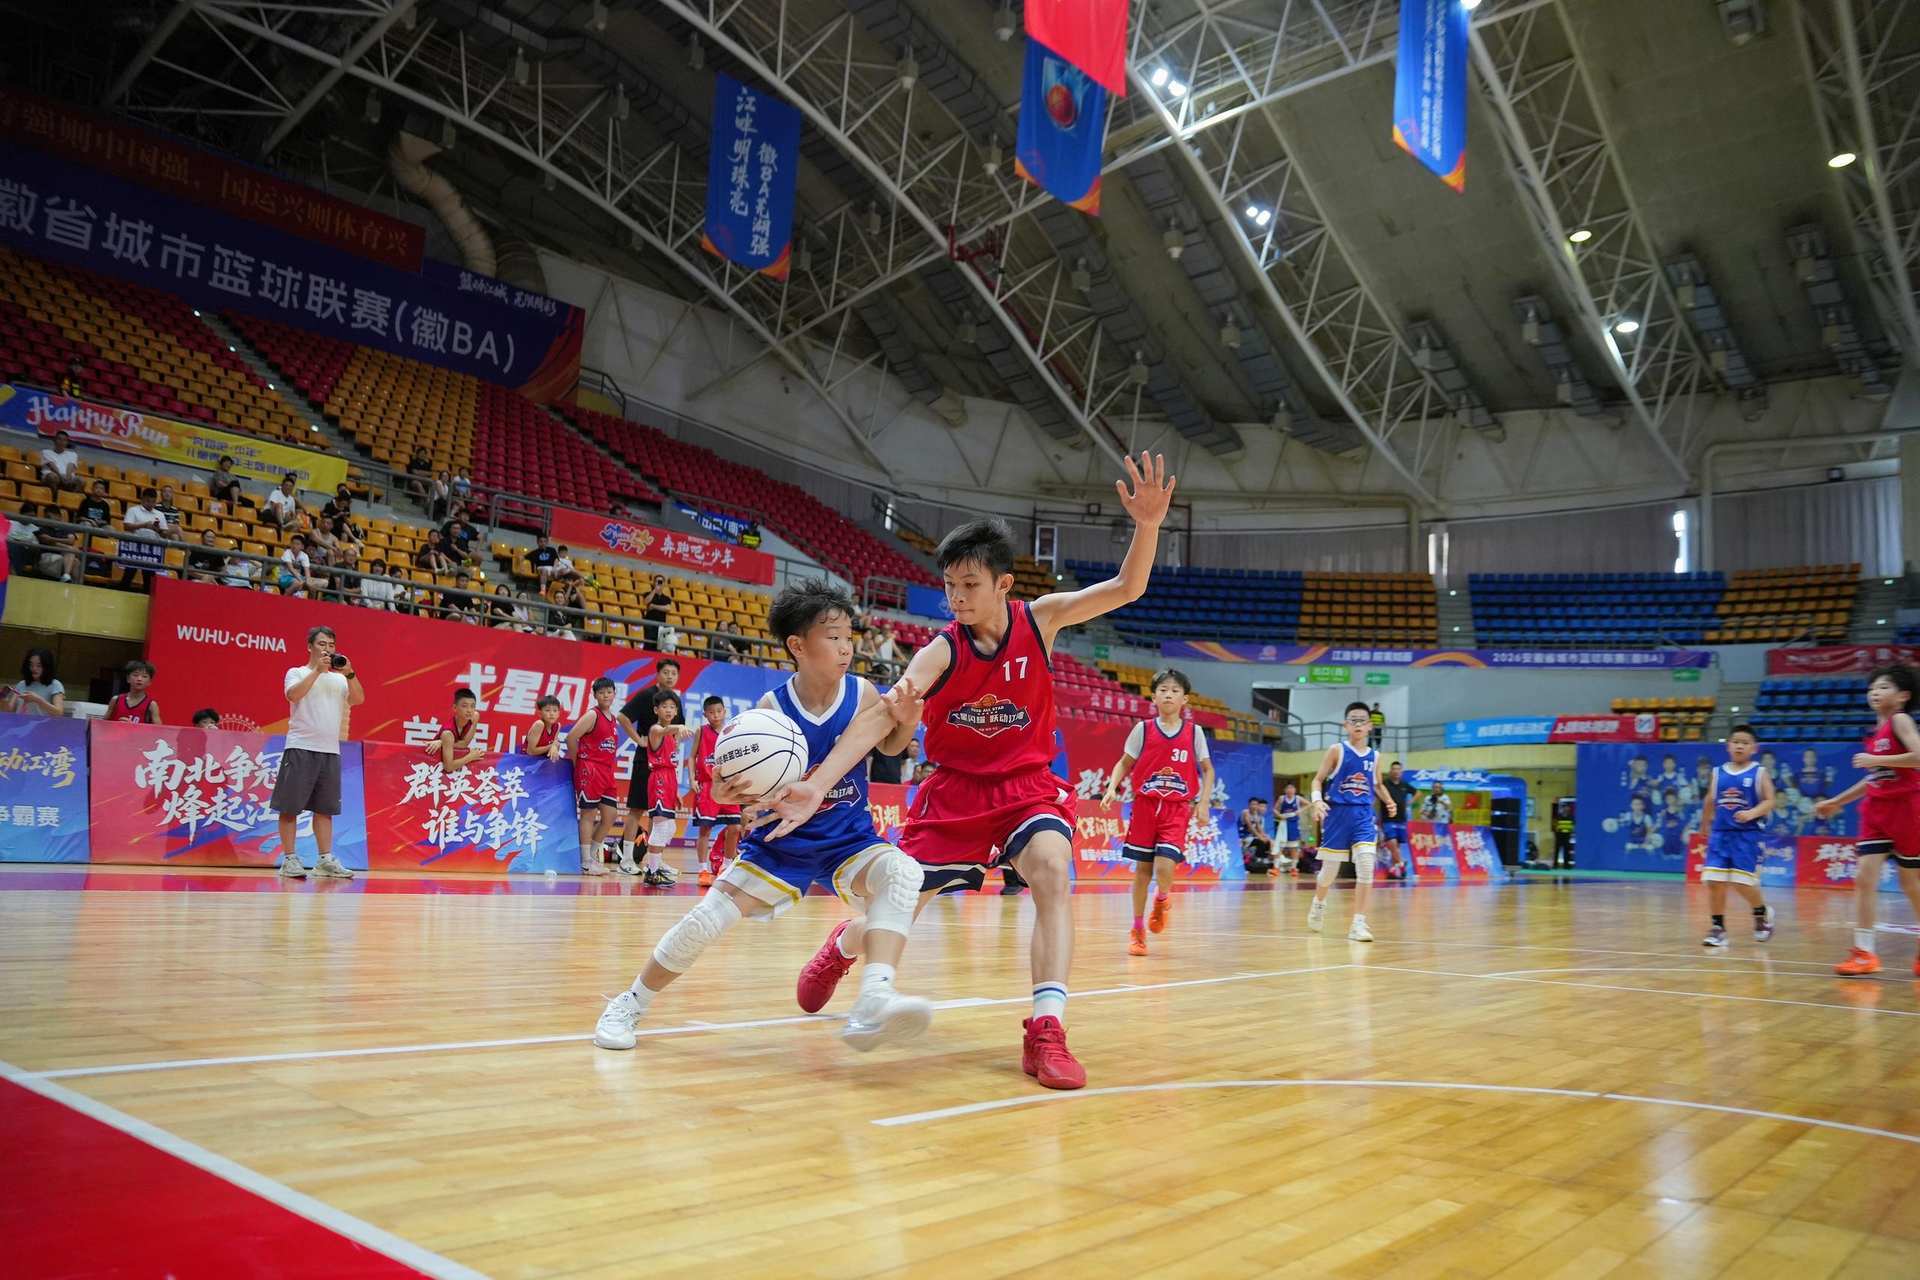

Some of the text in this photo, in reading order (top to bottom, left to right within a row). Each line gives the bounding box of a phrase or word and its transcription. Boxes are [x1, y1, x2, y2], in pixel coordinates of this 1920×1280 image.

[26, 395, 171, 448] Happy Run
[176, 624, 287, 653] WUHU·CHINA
[1002, 656, 1028, 682] 17
[1170, 748, 1188, 763] 30
[397, 761, 531, 809] 群英荟萃
[421, 805, 549, 857] 谁与争锋
